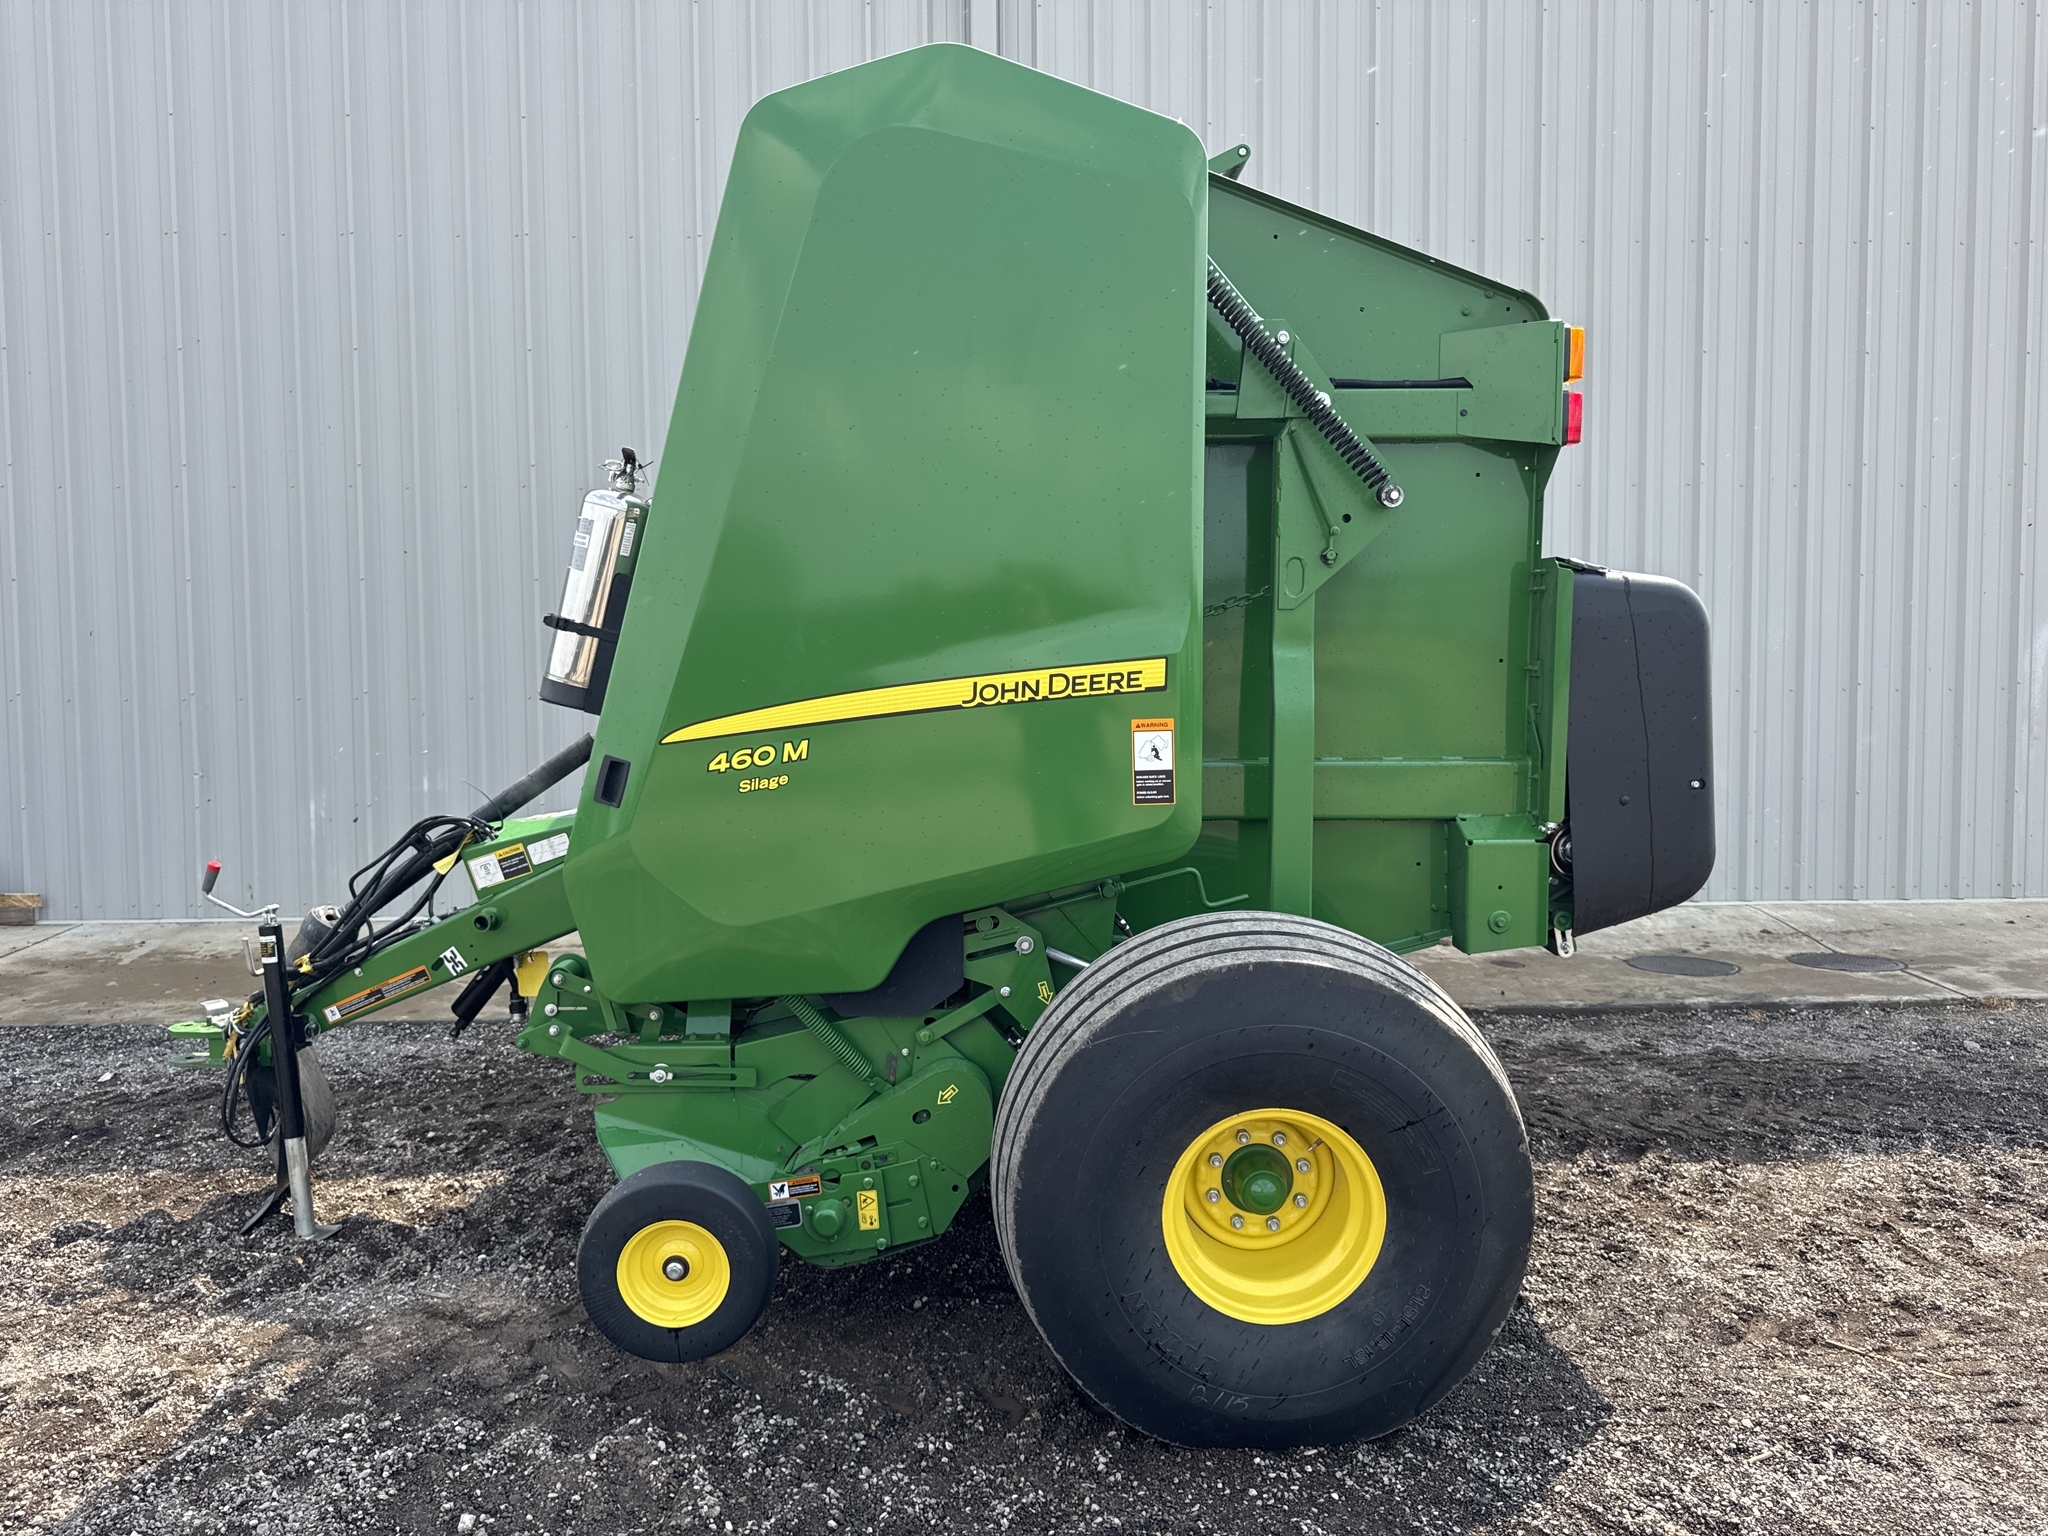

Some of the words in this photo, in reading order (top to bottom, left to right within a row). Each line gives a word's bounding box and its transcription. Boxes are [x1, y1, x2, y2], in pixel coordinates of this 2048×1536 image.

[961, 679, 1041, 705] JOHN
[1048, 670, 1143, 696] DEERE
[707, 744, 777, 774] 460
[781, 738, 810, 764] M
[738, 774, 790, 793] Silage
[1120, 1289, 1219, 1380] TITAN
